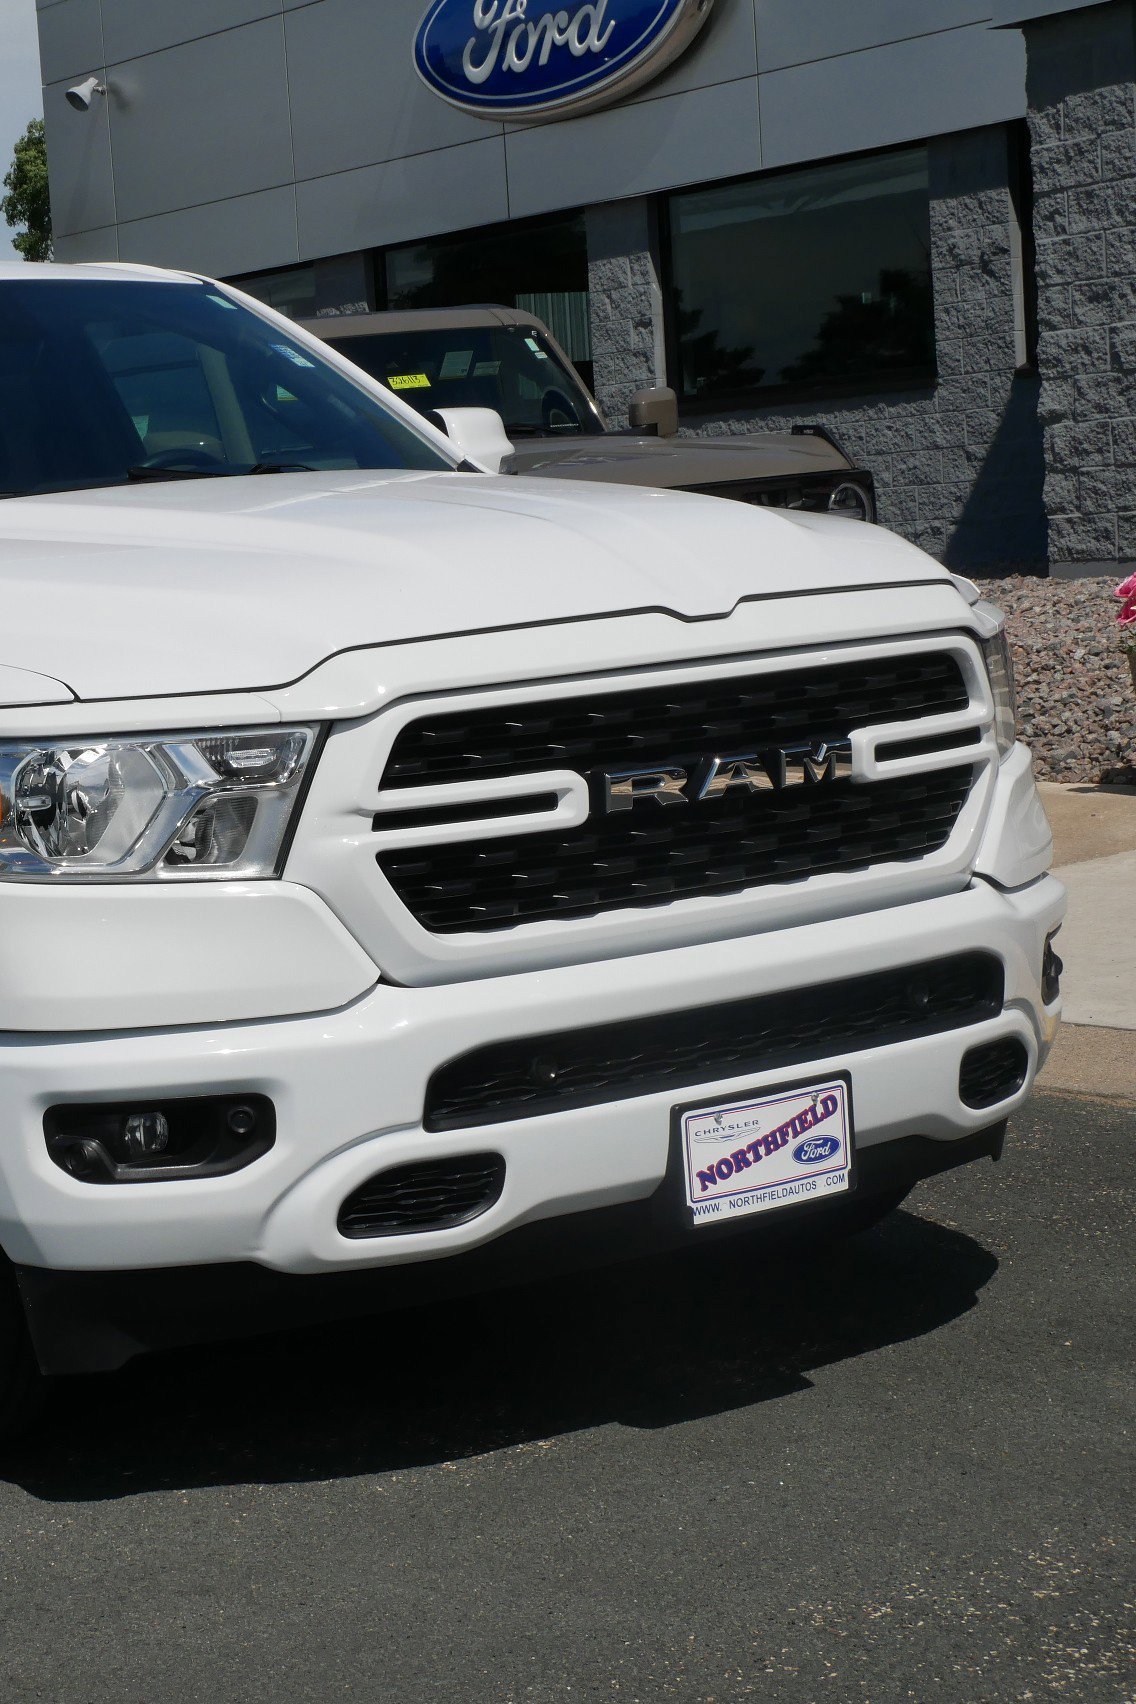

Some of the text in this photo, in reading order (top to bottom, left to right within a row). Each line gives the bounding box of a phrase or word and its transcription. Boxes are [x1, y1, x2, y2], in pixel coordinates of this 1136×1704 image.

[462, 0, 616, 85] Ford
[604, 737, 854, 813] RAM
[694, 1119, 760, 1137] CHRYSLER
[695, 1093, 839, 1193] NORTHFIELD
[800, 1139, 831, 1161] Ford
[729, 1180, 817, 1209] NORTHFIELDAUTOS
